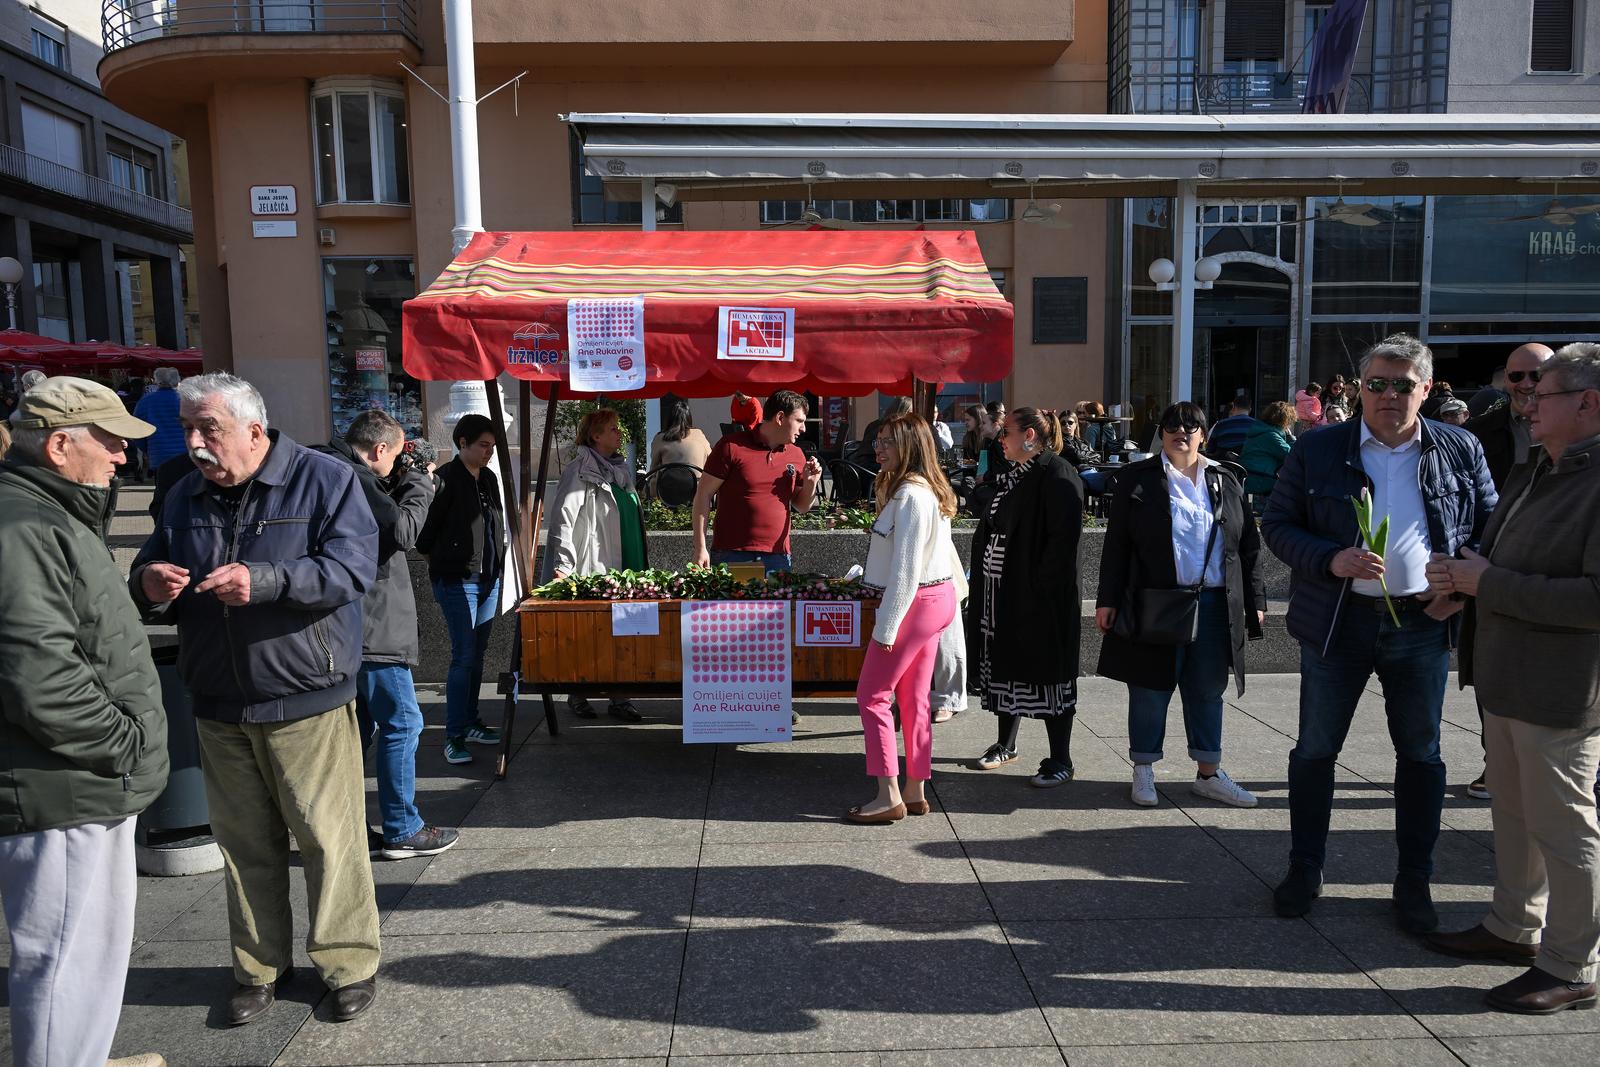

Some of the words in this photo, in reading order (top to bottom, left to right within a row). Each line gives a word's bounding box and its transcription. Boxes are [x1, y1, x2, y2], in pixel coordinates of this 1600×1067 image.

[258, 202, 290, 212] JELAČIĆA
[1529, 229, 1576, 255] KRAŠ
[577, 340, 605, 348] Omiljeni
[508, 346, 559, 365] tržnice
[596, 346, 634, 355] Rukavine
[693, 690, 744, 701] Omiljeni
[748, 690, 783, 701] cvijet
[693, 703, 717, 712] Ane
[720, 702, 780, 712] Rukavine
